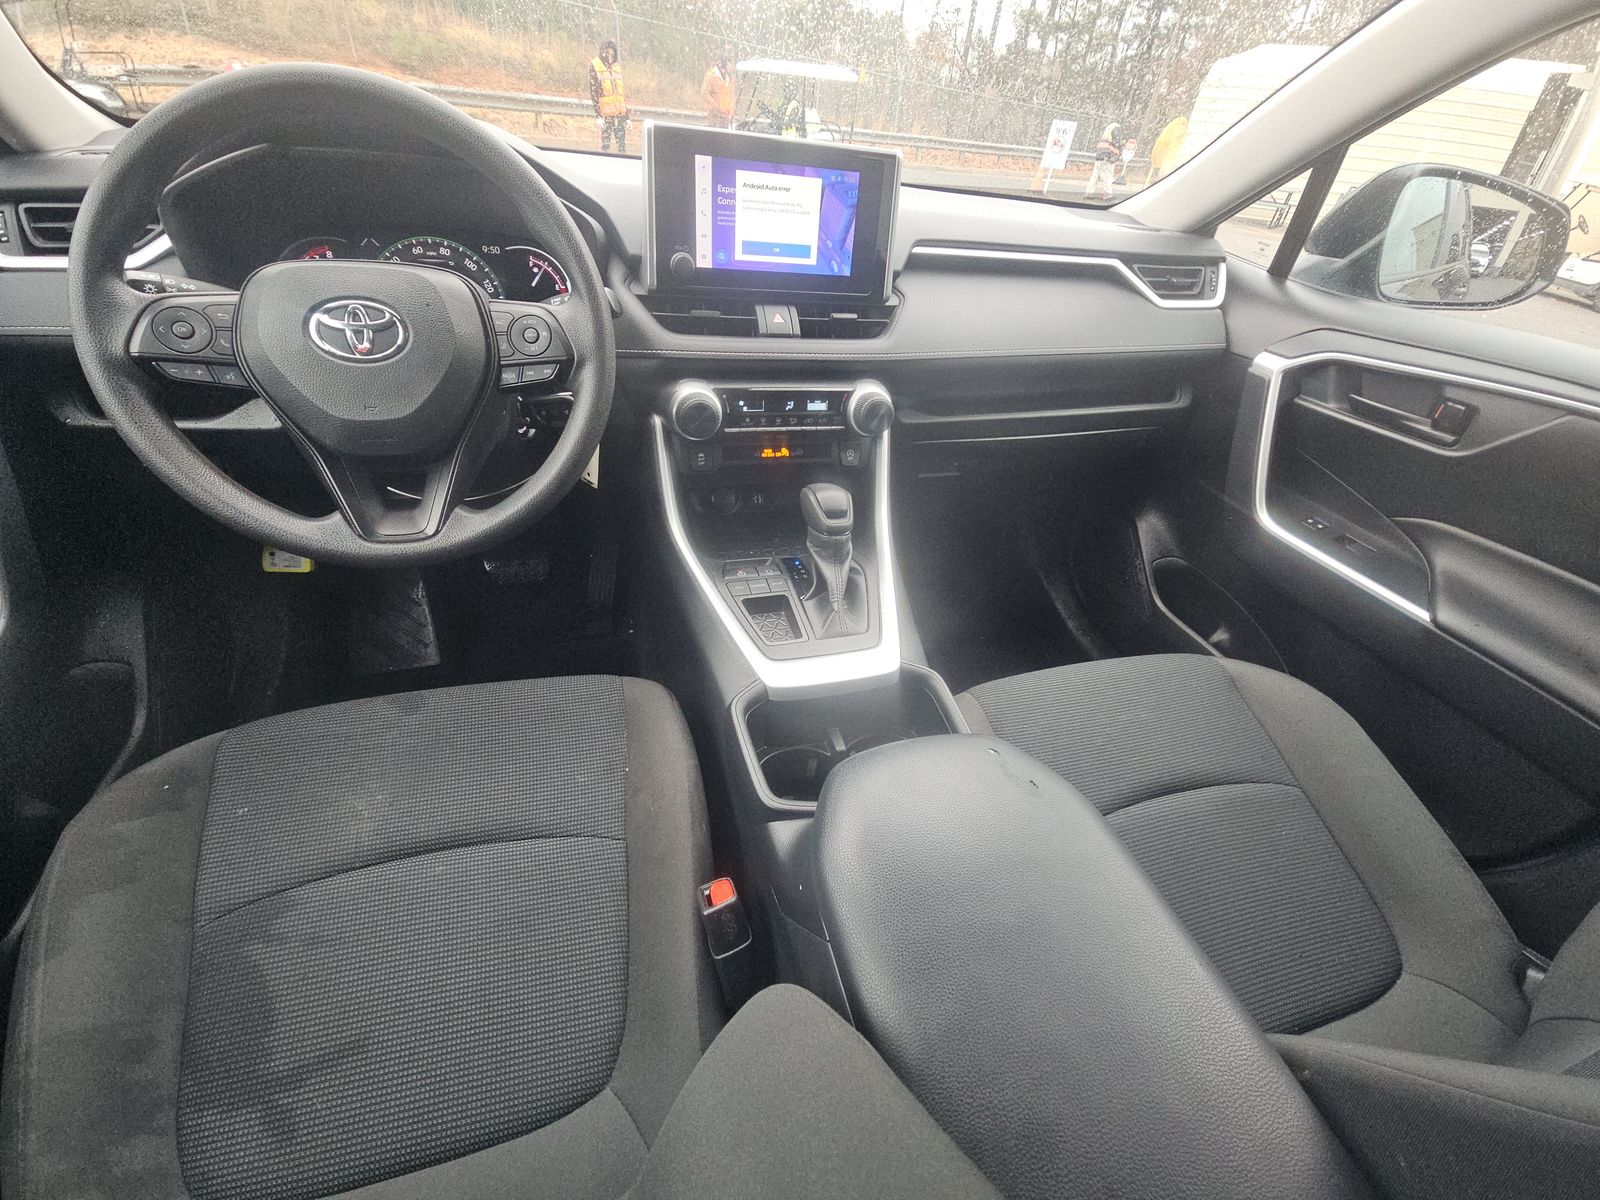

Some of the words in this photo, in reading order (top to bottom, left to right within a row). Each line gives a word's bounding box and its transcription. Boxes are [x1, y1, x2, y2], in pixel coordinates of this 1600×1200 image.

[742, 182, 764, 190] Android
[412, 246, 423, 255] 60
[439, 247, 451, 256] 80
[481, 245, 500, 254] 9:50
[325, 250, 333, 259] 8
[463, 258, 478, 271] 100
[483, 279, 495, 294] 120
